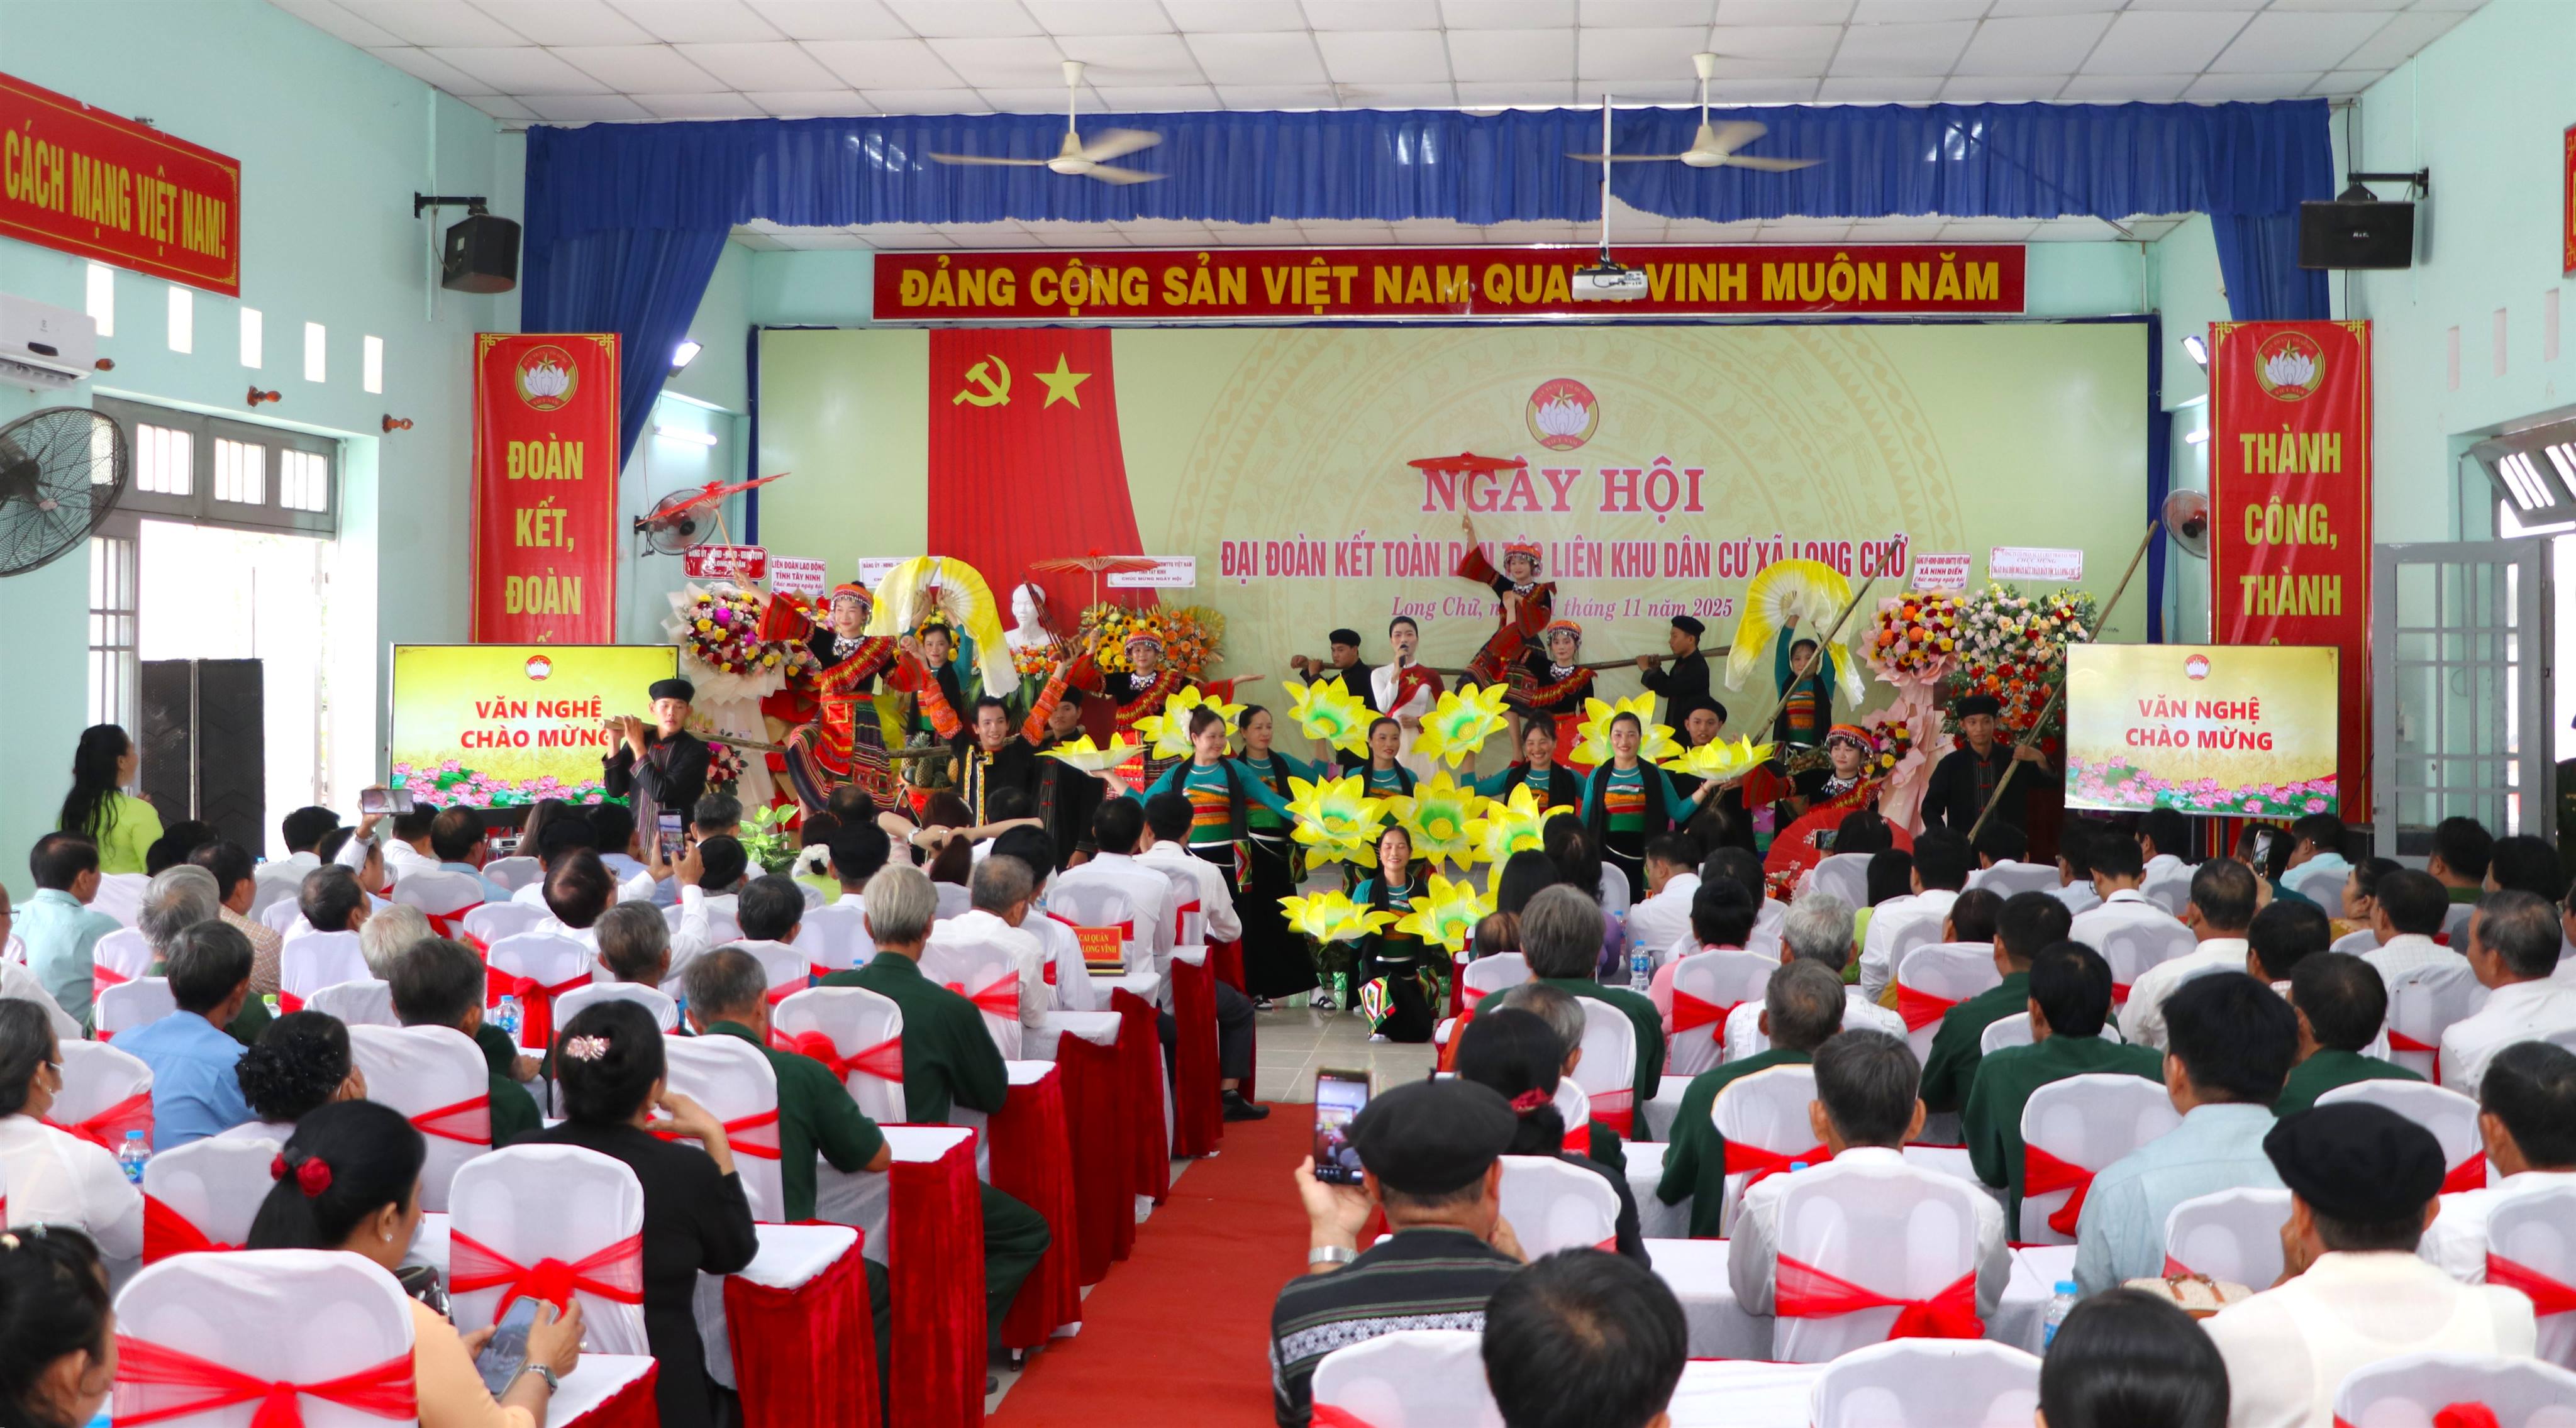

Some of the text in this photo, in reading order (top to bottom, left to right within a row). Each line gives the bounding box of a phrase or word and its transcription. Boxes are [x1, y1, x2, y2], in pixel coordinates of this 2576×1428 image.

[5, 120, 226, 260] CÁCH MẠNG VIỆT NAM!
[901, 252, 1999, 316] ĐẢNG CỘNG SẢN VIỆT NAM QUA VINH MUÔN NĂM
[507, 432, 584, 480] ĐOÀN
[2240, 423, 2341, 474] THÀNH
[1422, 455, 1705, 524] NGÀY HỘI
[516, 495, 575, 552] KẾT,
[2245, 495, 2338, 550] CÔNG,
[772, 559, 825, 573] LIÊN ĐOÀN LAO ĐỘNG
[775, 570, 821, 582] TỈNH TÂY NINH
[1221, 540, 1258, 585] ĐẠI
[1265, 533, 1324, 577] ĐOÀN
[1335, 529, 1376, 577] KẾT
[1382, 533, 1441, 577] TOÀN
[1448, 541, 1495, 577] DN
[1552, 534, 1603, 578] LIÊN
[1611, 542, 1657, 578] KHU
[1663, 534, 1711, 578] DÂN
[1718, 536, 1752, 578] CƯ
[1755, 534, 1785, 577] XÃ
[1860, 533, 1909, 578] CHỮ
[505, 567, 582, 615] ĐOÀN
[1392, 596, 1436, 621] Long
[1442, 596, 1482, 620] Chữ,
[1563, 597, 1616, 621] tháng
[1624, 598, 1641, 617] 11
[1648, 597, 1687, 617] năm
[1692, 598, 1733, 617] 2025
[2240, 566, 2341, 616] THÀNH
[475, 695, 602, 722] VĂN NGHỆ
[2138, 694, 2261, 726] VĂN NGHỆ
[460, 724, 609, 749] CHÀO MỪNG
[2125, 724, 2273, 751] CHÀO MỪNG
[1079, 932, 1109, 944] CAI QUẢN
[1082, 944, 1100, 953] LONG
